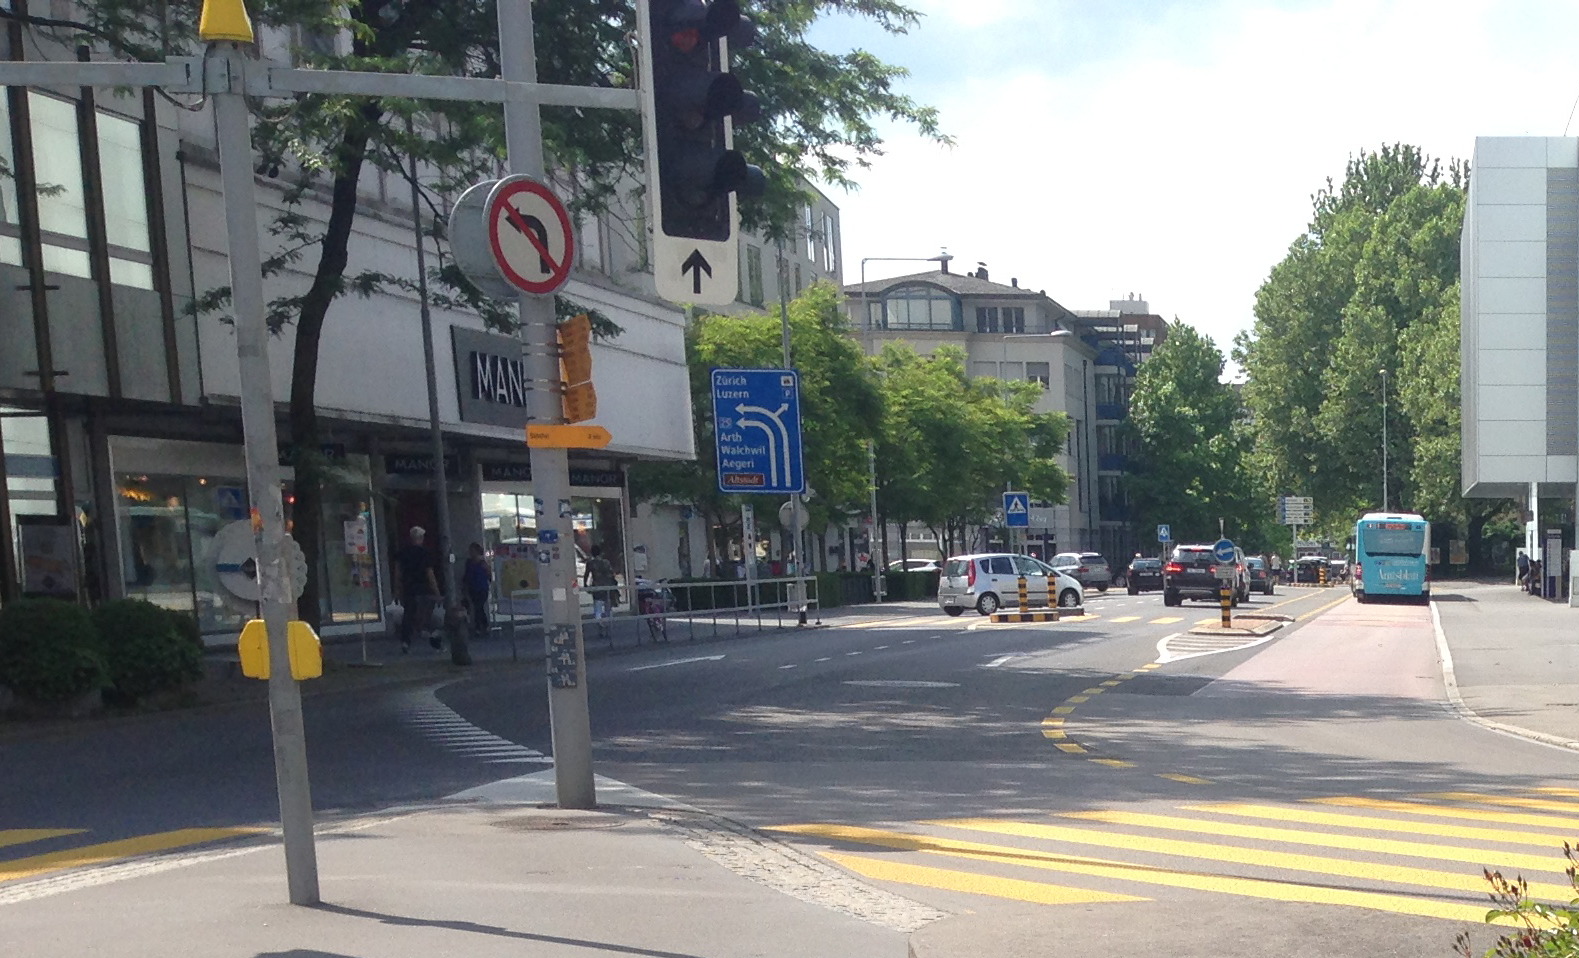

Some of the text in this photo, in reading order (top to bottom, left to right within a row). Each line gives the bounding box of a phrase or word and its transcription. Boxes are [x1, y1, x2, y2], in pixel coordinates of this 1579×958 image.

[476, 351, 524, 405] MAN
[716, 375, 747, 386] Zürich
[716, 389, 750, 399] Luzern
[720, 432, 743, 442] Arth
[721, 445, 766, 455] Walchwil
[722, 459, 755, 470] Aegeri
